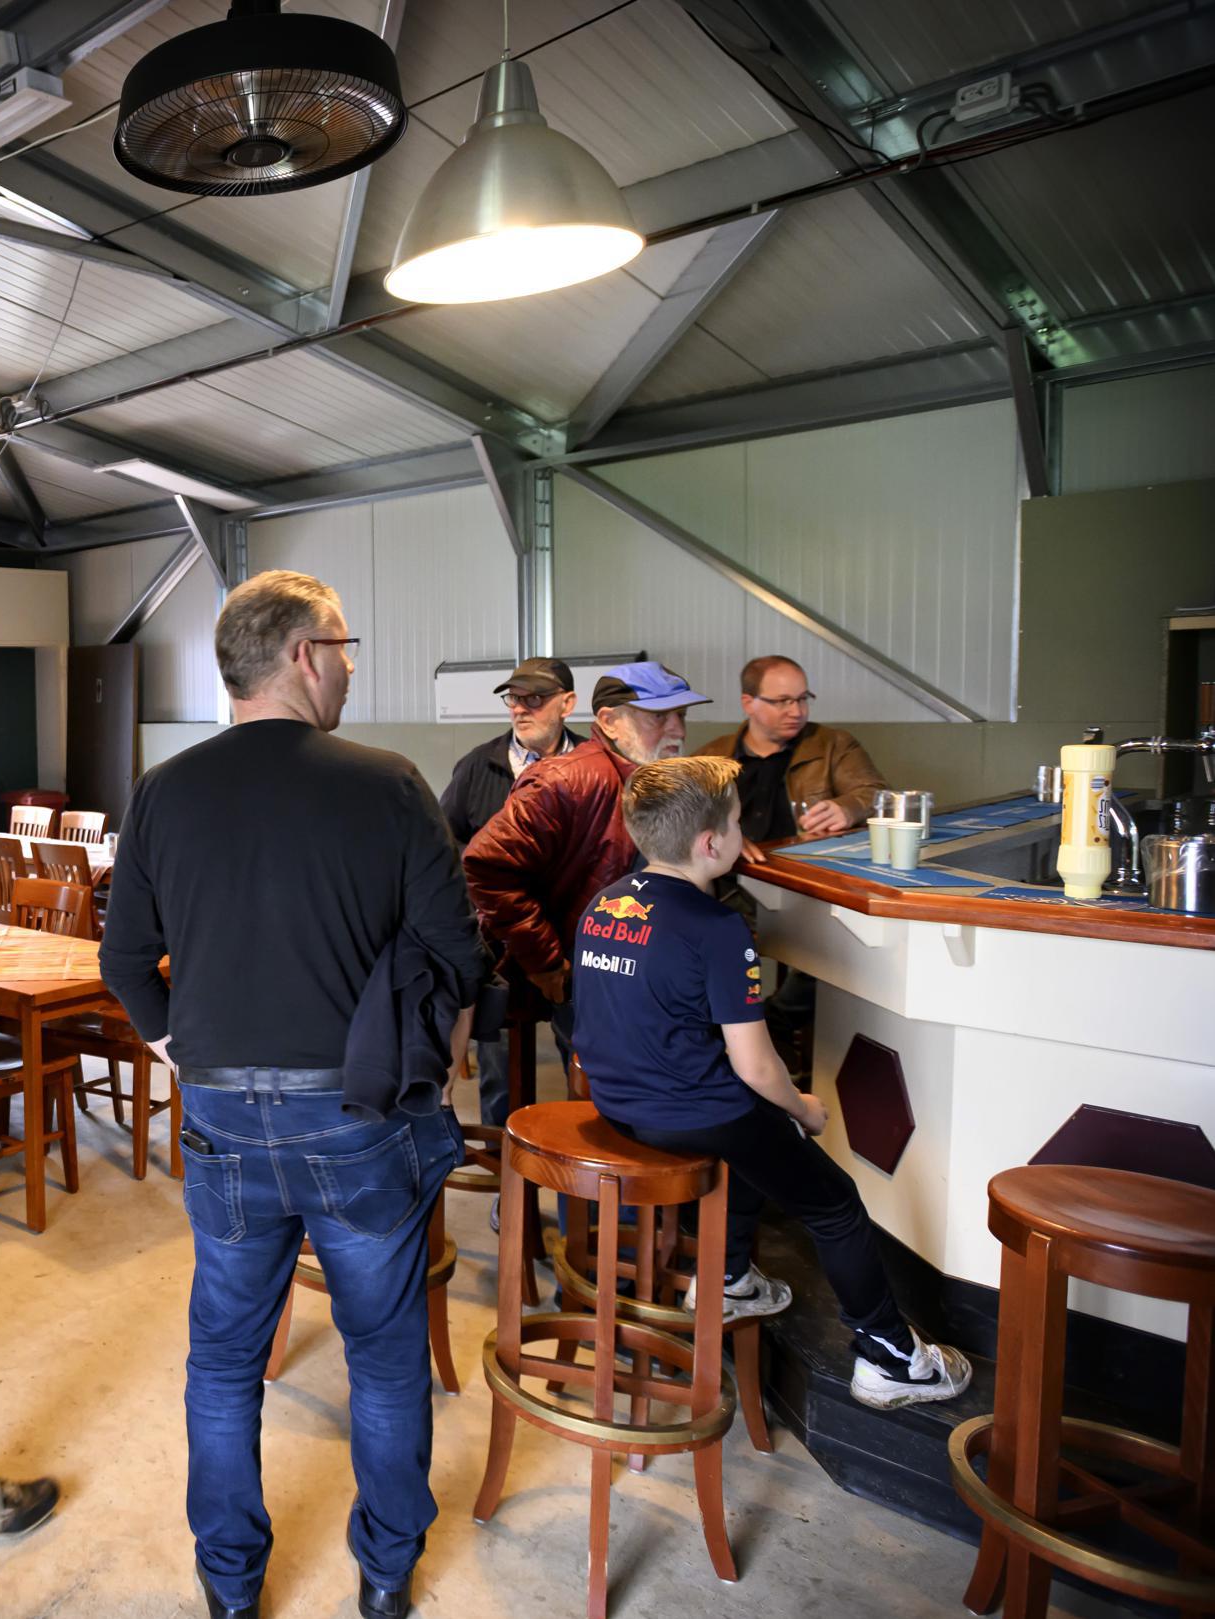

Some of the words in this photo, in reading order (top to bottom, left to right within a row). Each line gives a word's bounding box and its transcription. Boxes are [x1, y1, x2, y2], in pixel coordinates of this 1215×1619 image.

[583, 916, 616, 939] Red
[614, 922, 653, 946] Bull
[581, 950, 620, 973] Mobil
